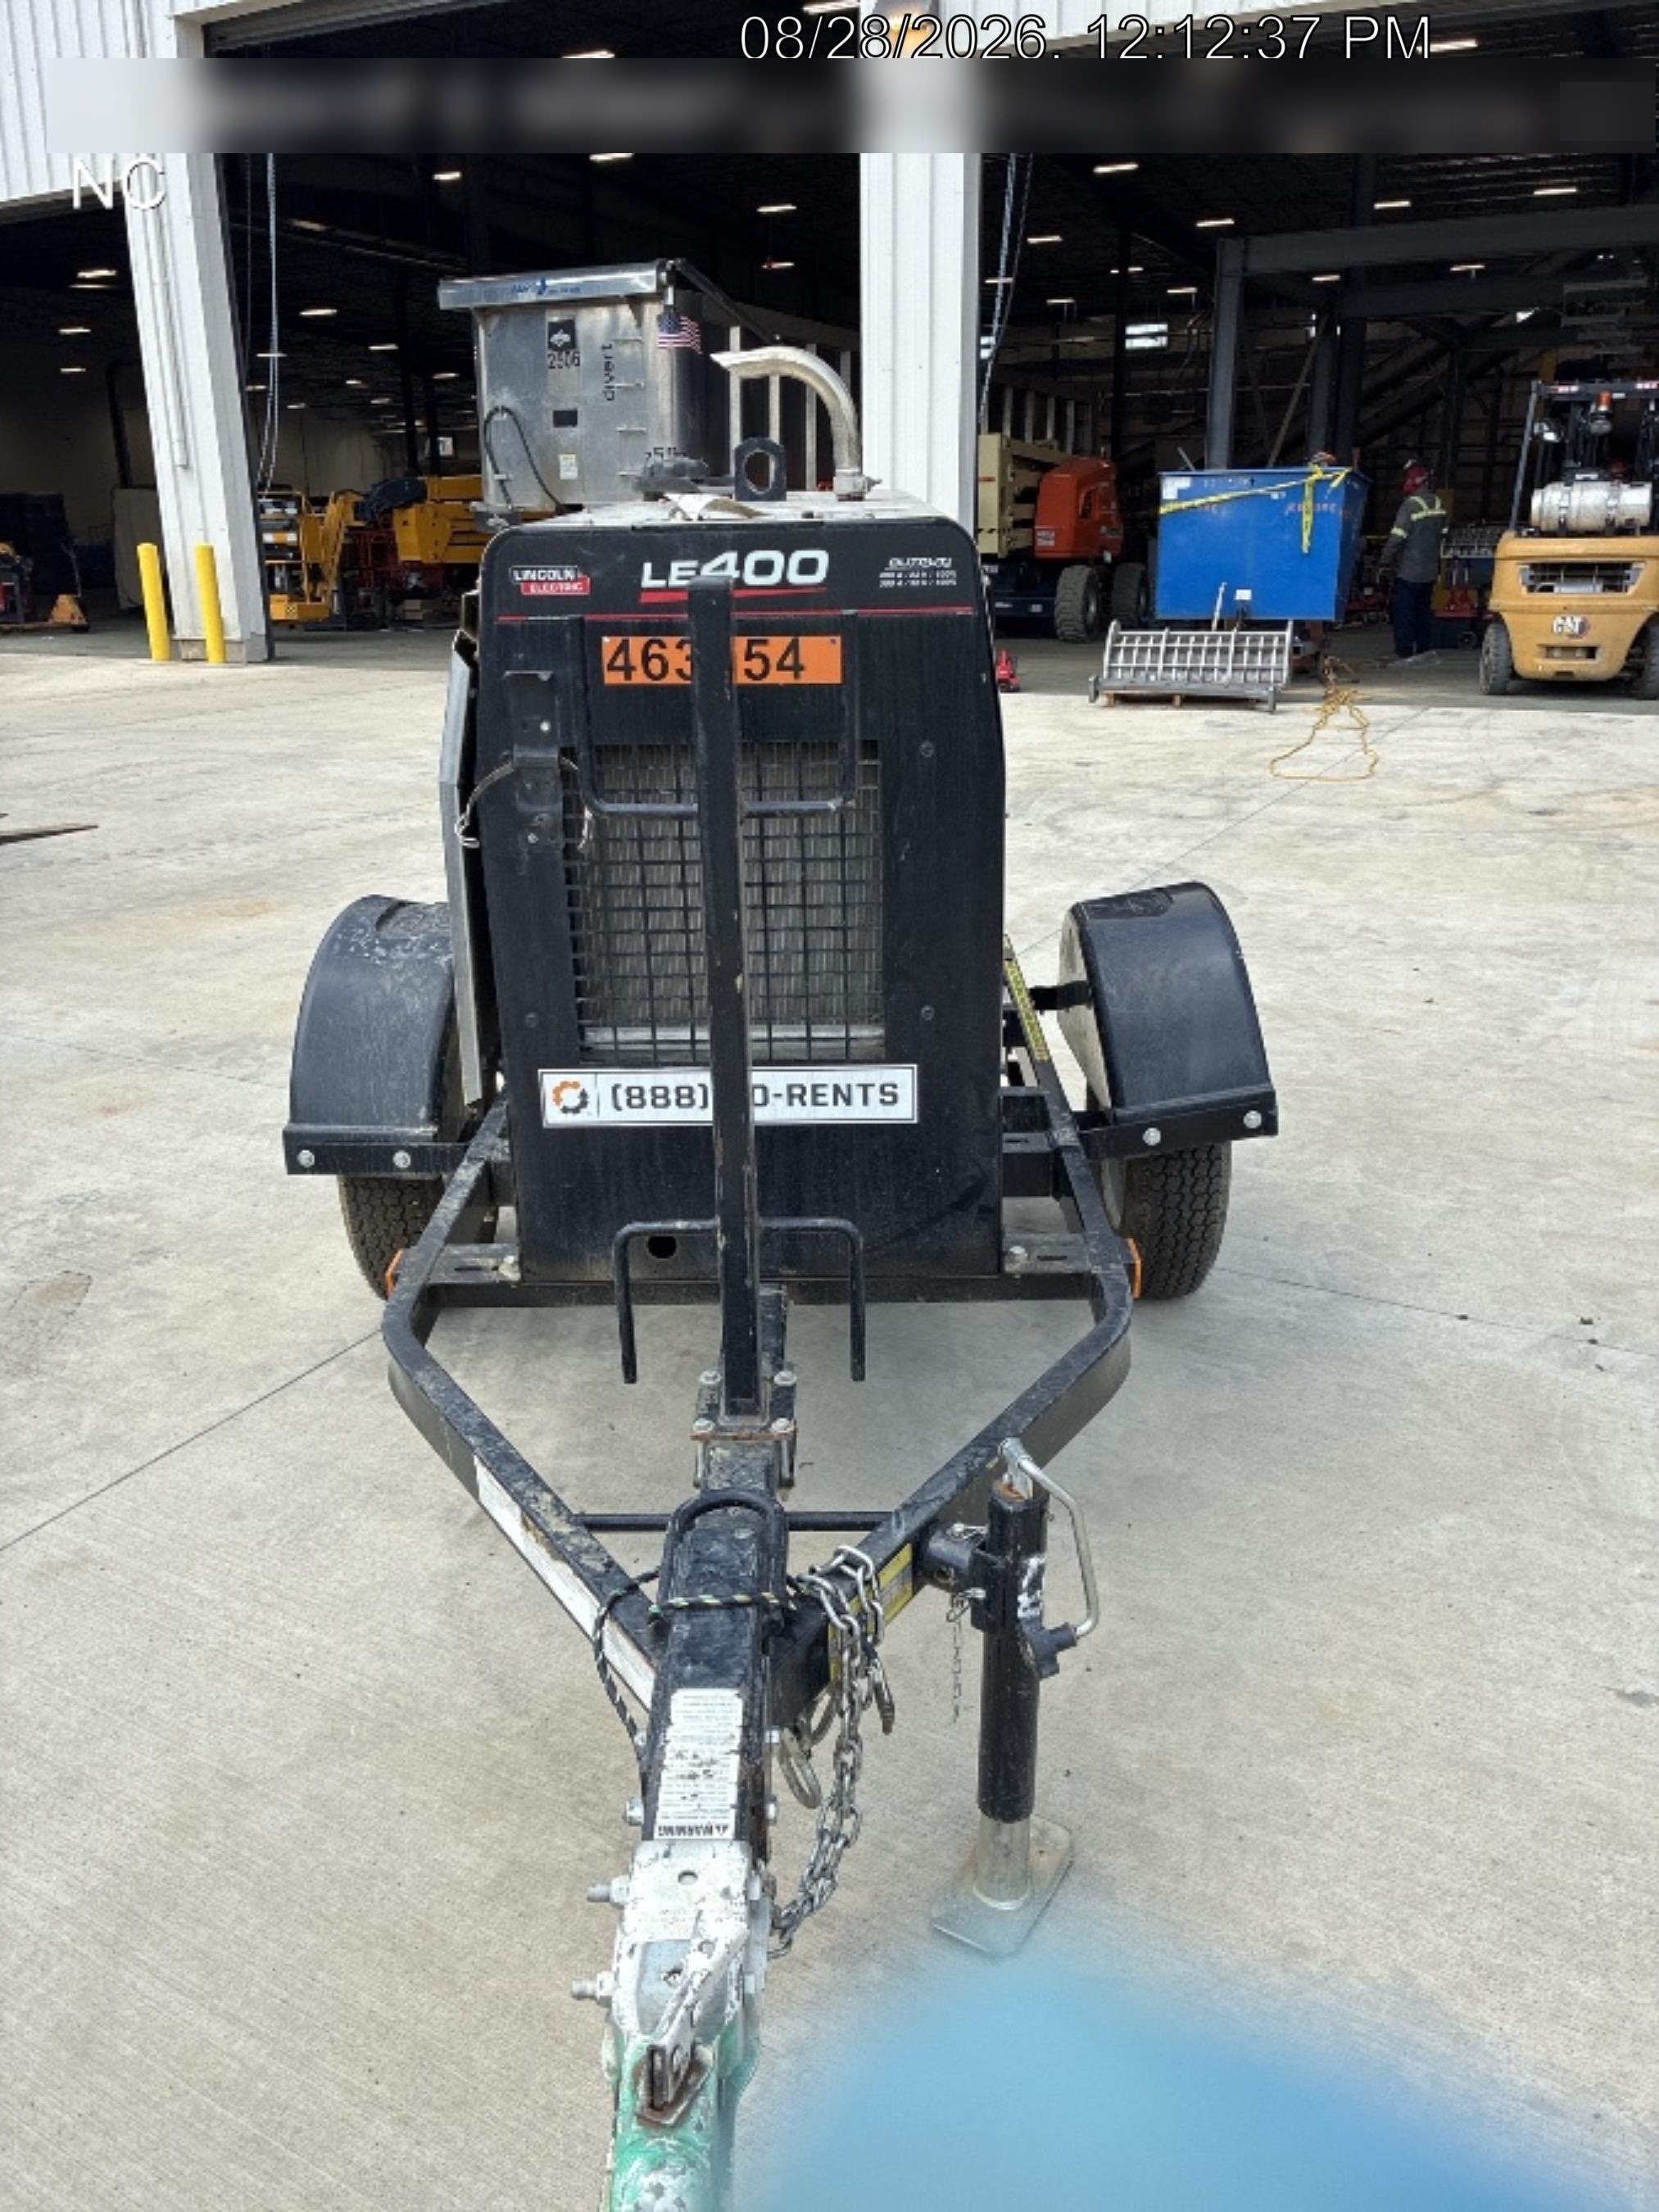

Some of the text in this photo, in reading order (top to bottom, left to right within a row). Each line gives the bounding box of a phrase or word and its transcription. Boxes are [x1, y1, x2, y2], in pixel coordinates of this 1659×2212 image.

[512, 569, 576, 581] LINCOLN
[641, 550, 829, 588] LE400
[605, 637, 805, 682] 46354
[611, 1083, 709, 1111] (888)
